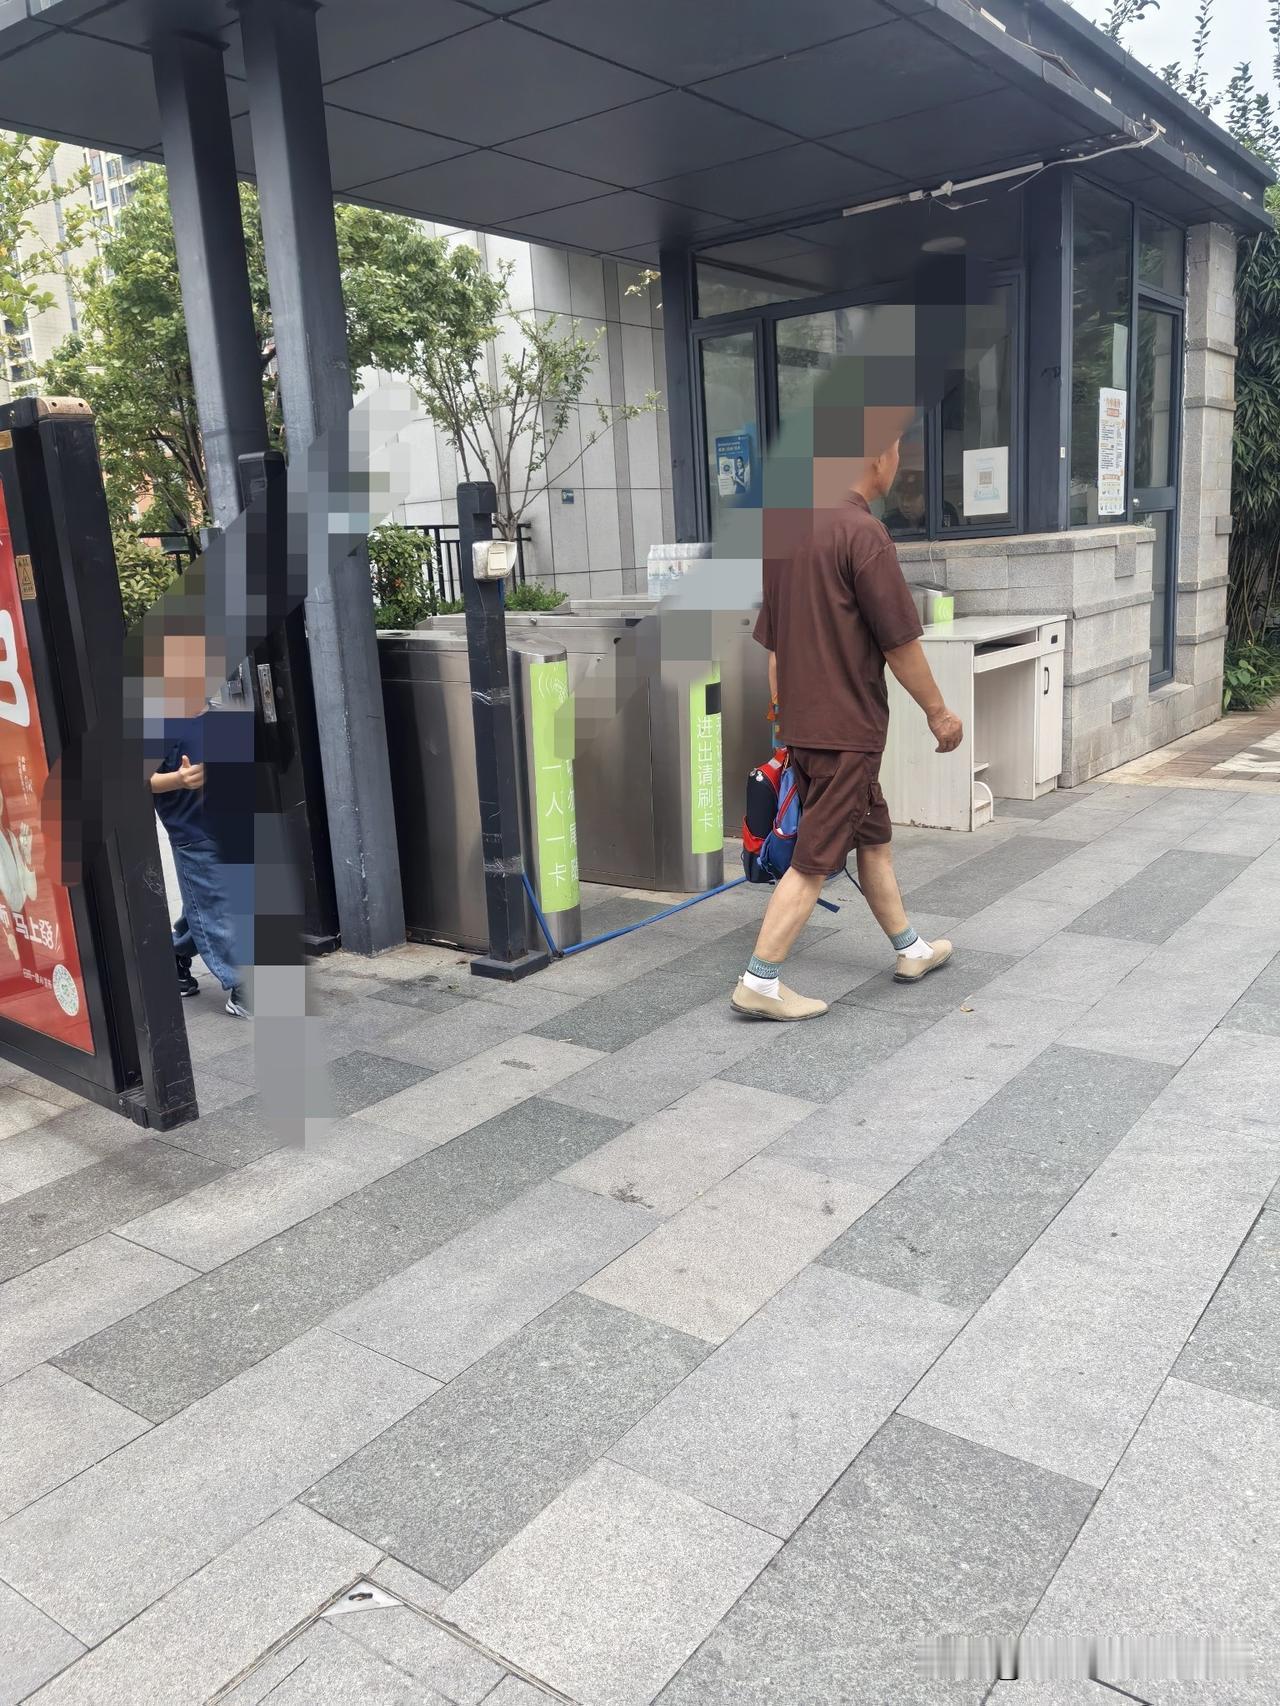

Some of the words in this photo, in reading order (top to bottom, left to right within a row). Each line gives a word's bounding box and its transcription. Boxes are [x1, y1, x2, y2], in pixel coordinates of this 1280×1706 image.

[542, 765, 566, 887] 一人一卡
[697, 717, 713, 832] 进出请刷卡
